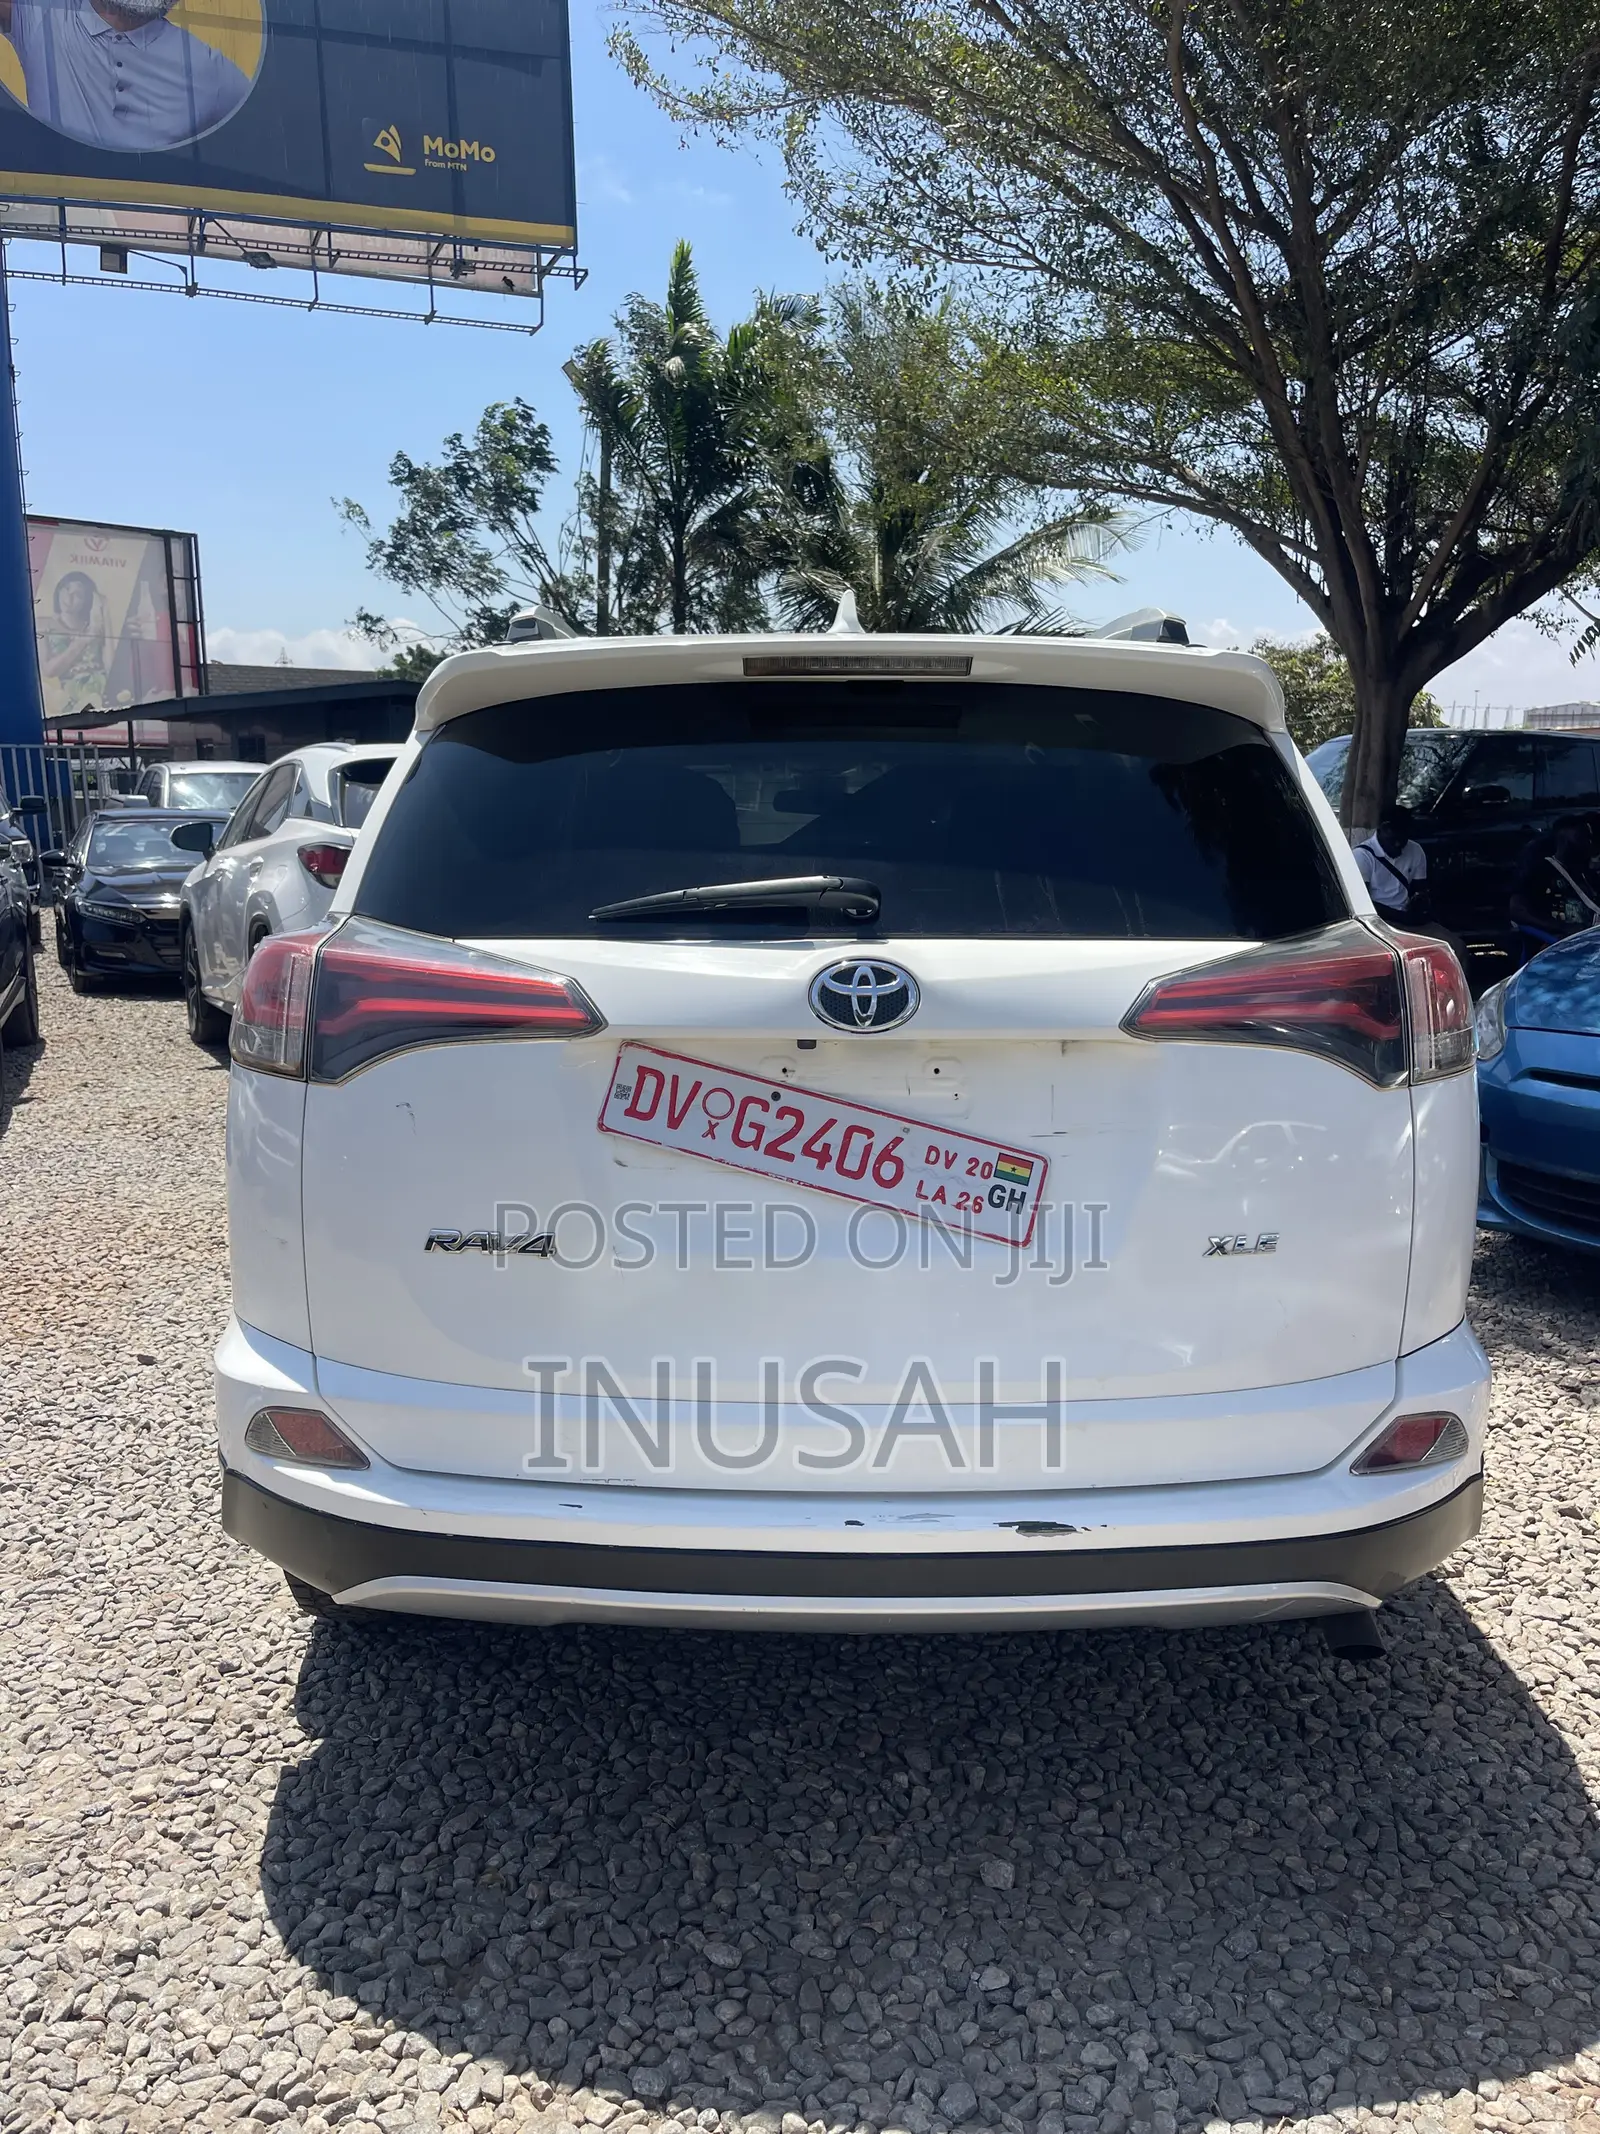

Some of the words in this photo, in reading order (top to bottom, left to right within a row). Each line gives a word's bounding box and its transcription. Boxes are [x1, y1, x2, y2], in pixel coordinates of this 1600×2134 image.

[423, 135, 496, 163] MoMo
[424, 159, 446, 169] from
[447, 161, 467, 171] MTN
[624, 1065, 703, 1130] DV
[924, 1145, 958, 1170] DV
[965, 1157, 994, 1180] 20
[915, 1179, 947, 1205] LA
[951, 1191, 985, 1214] 26
[987, 1184, 1027, 1215] GH
[424, 1228, 556, 1259] RAV4
[1202, 1233, 1280, 1257] XLE
